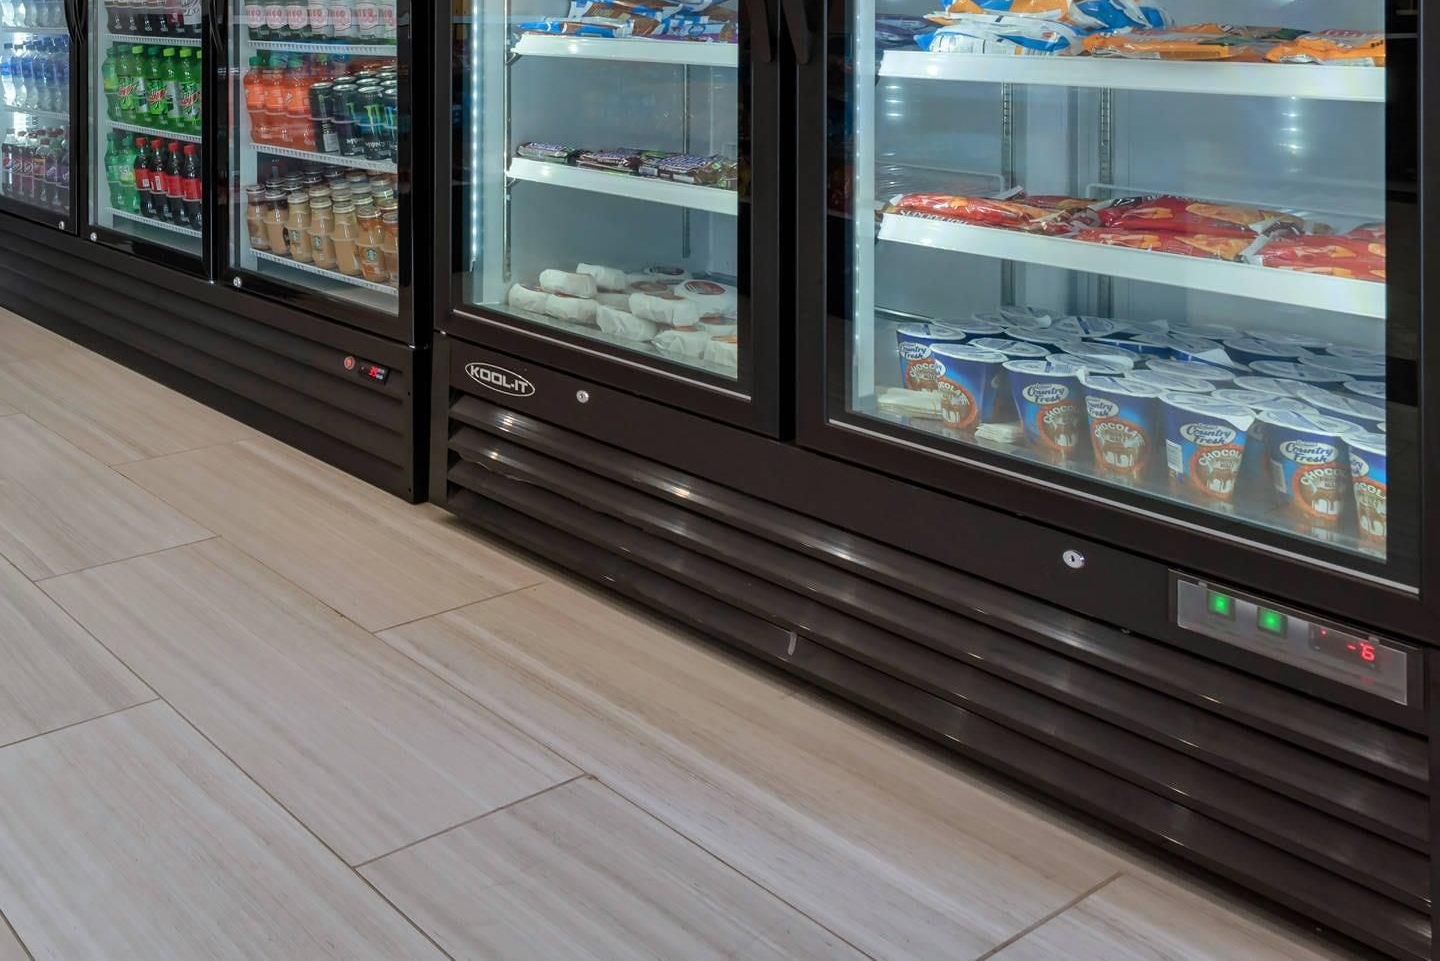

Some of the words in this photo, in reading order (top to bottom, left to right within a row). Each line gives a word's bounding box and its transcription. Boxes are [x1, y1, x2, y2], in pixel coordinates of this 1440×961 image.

[1027, 385, 1065, 397] Country
[1035, 392, 1061, 404] Fresh
[1186, 424, 1232, 439] Country
[1193, 434, 1225, 445] Fresh
[1285, 442, 1334, 456] Country
[1294, 453, 1328, 463] Fresh
